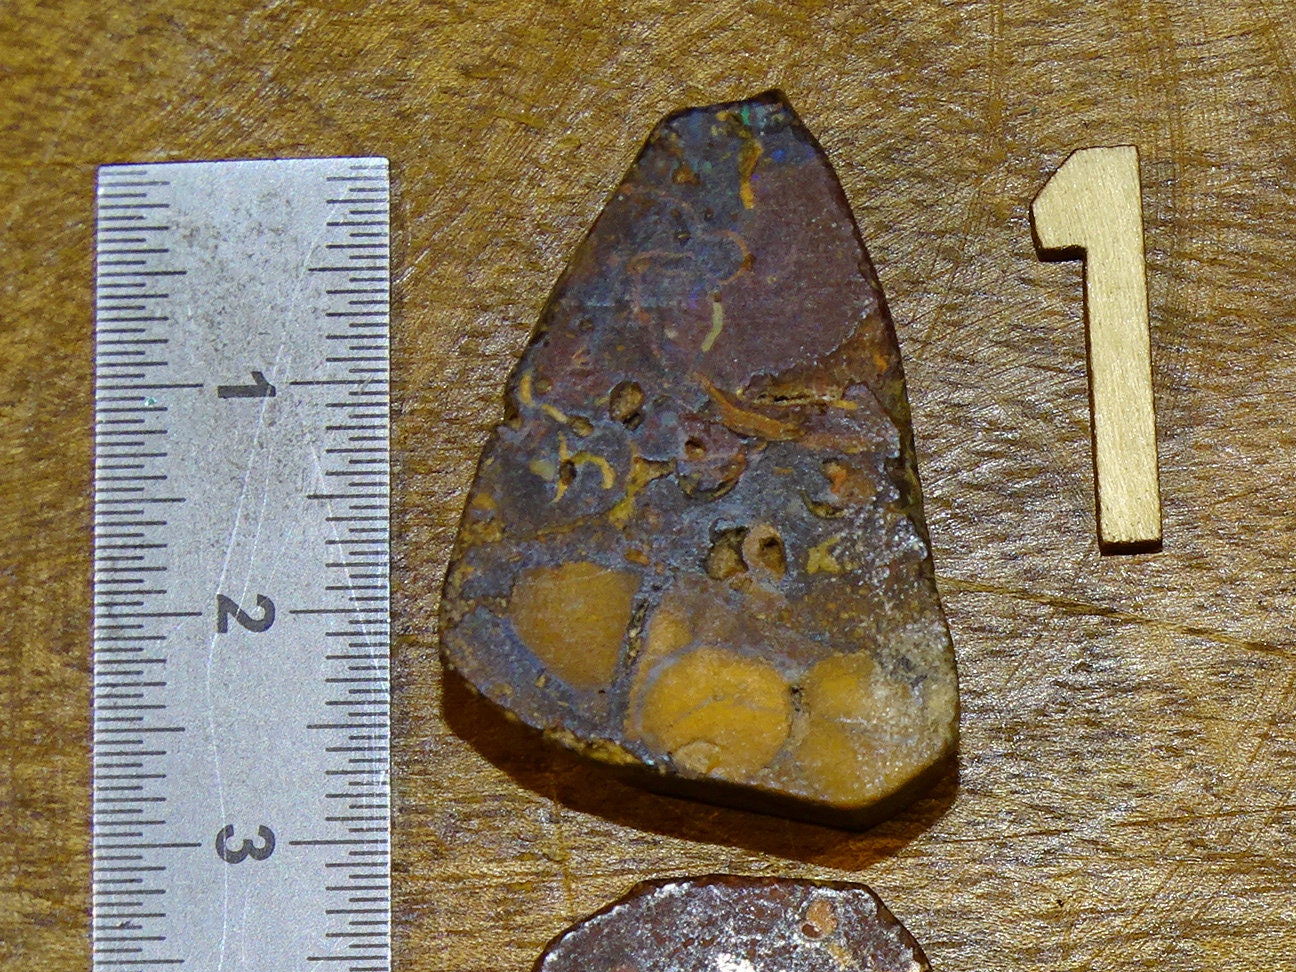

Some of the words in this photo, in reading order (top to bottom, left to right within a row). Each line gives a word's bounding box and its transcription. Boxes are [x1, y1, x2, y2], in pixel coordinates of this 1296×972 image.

[1030, 145, 1162, 548] 1
[217, 371, 276, 398] 1
[216, 593, 276, 633] 2
[215, 824, 276, 864] 3
